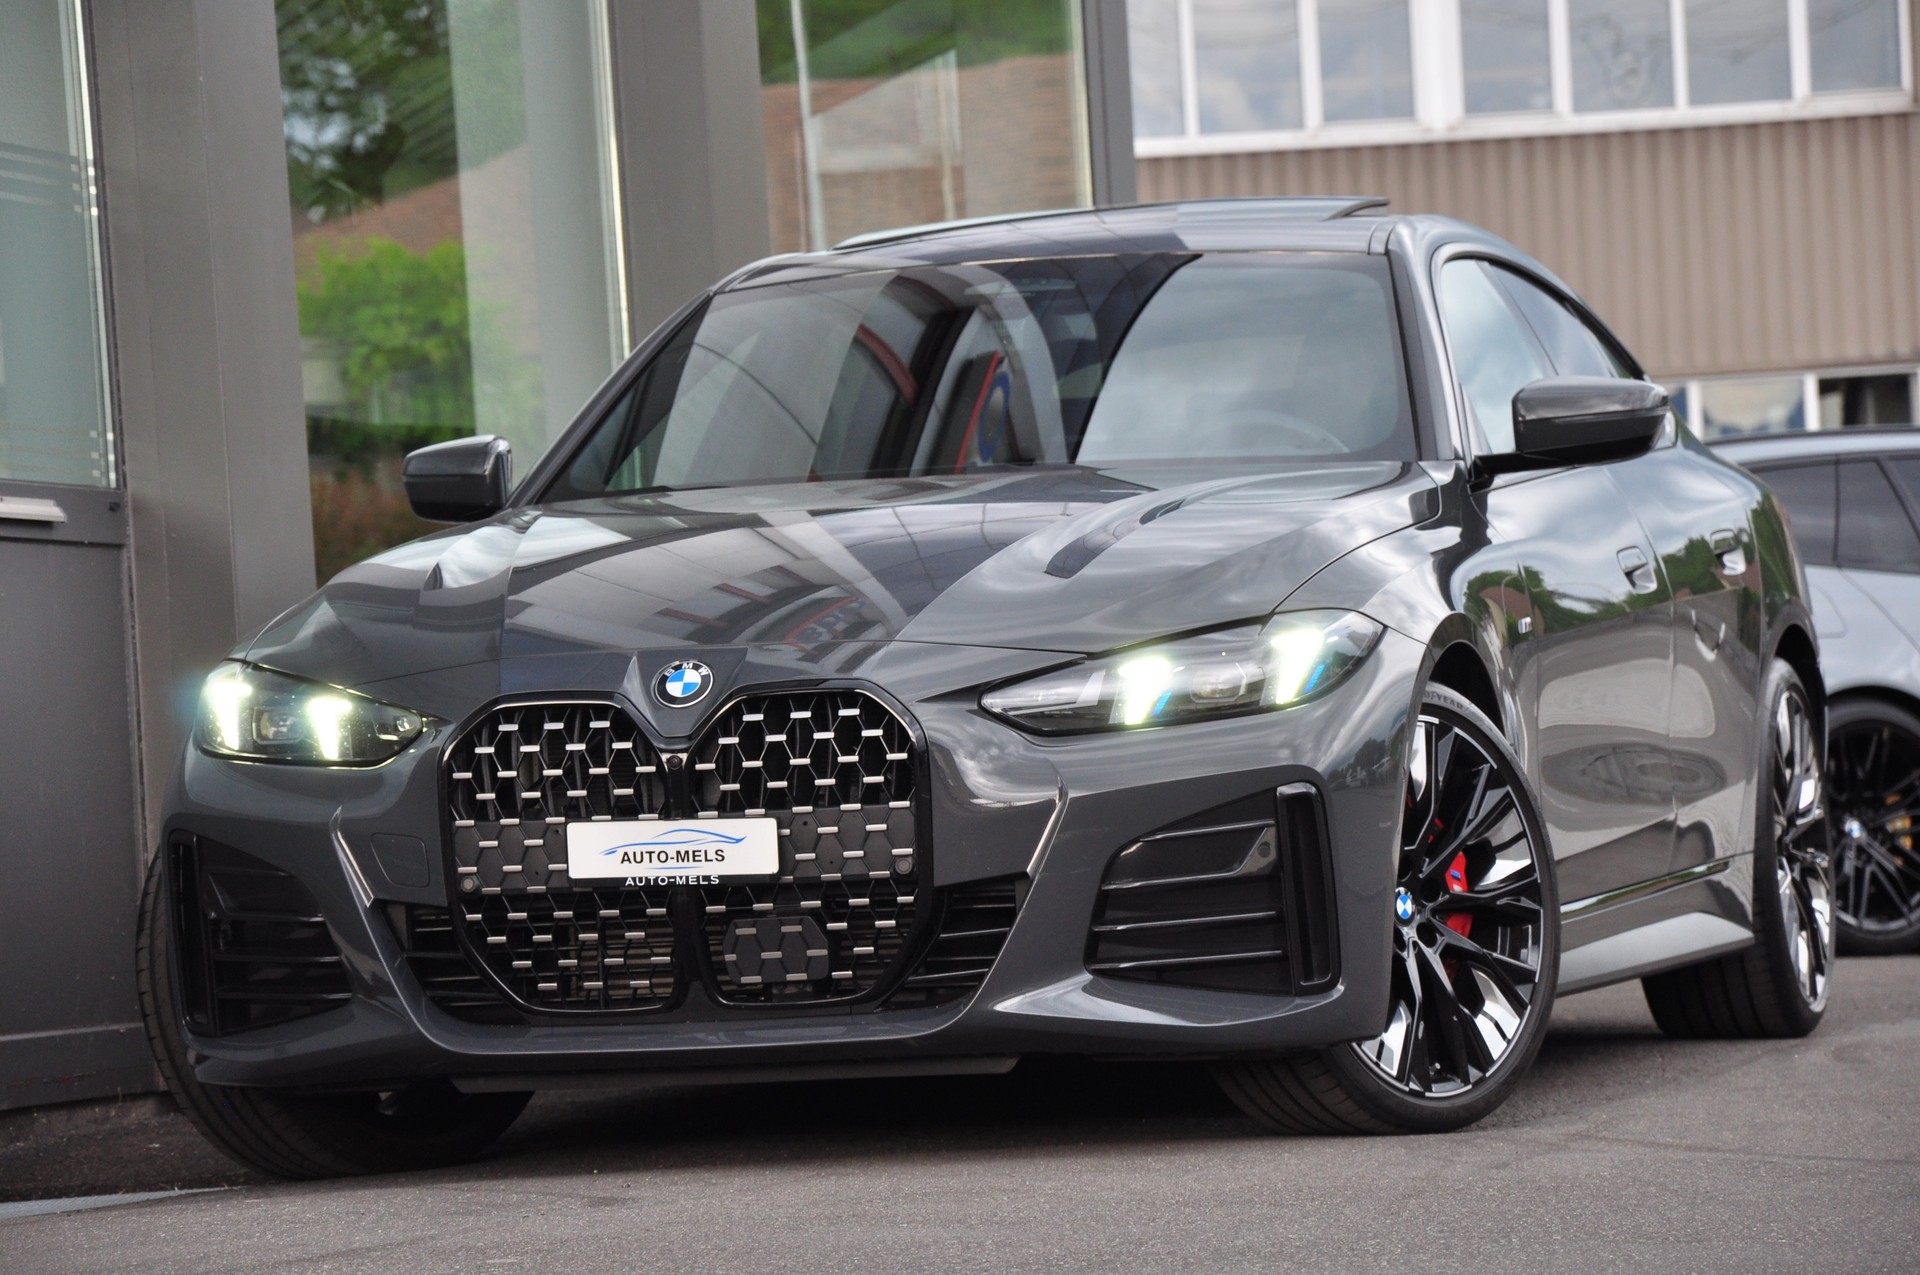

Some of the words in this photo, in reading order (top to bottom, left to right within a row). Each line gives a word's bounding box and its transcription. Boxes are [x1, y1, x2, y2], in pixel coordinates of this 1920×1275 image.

[663, 662, 710, 677] BMW
[620, 849, 726, 864] AUTO-MELS
[624, 874, 720, 886] AUTO-MELS
